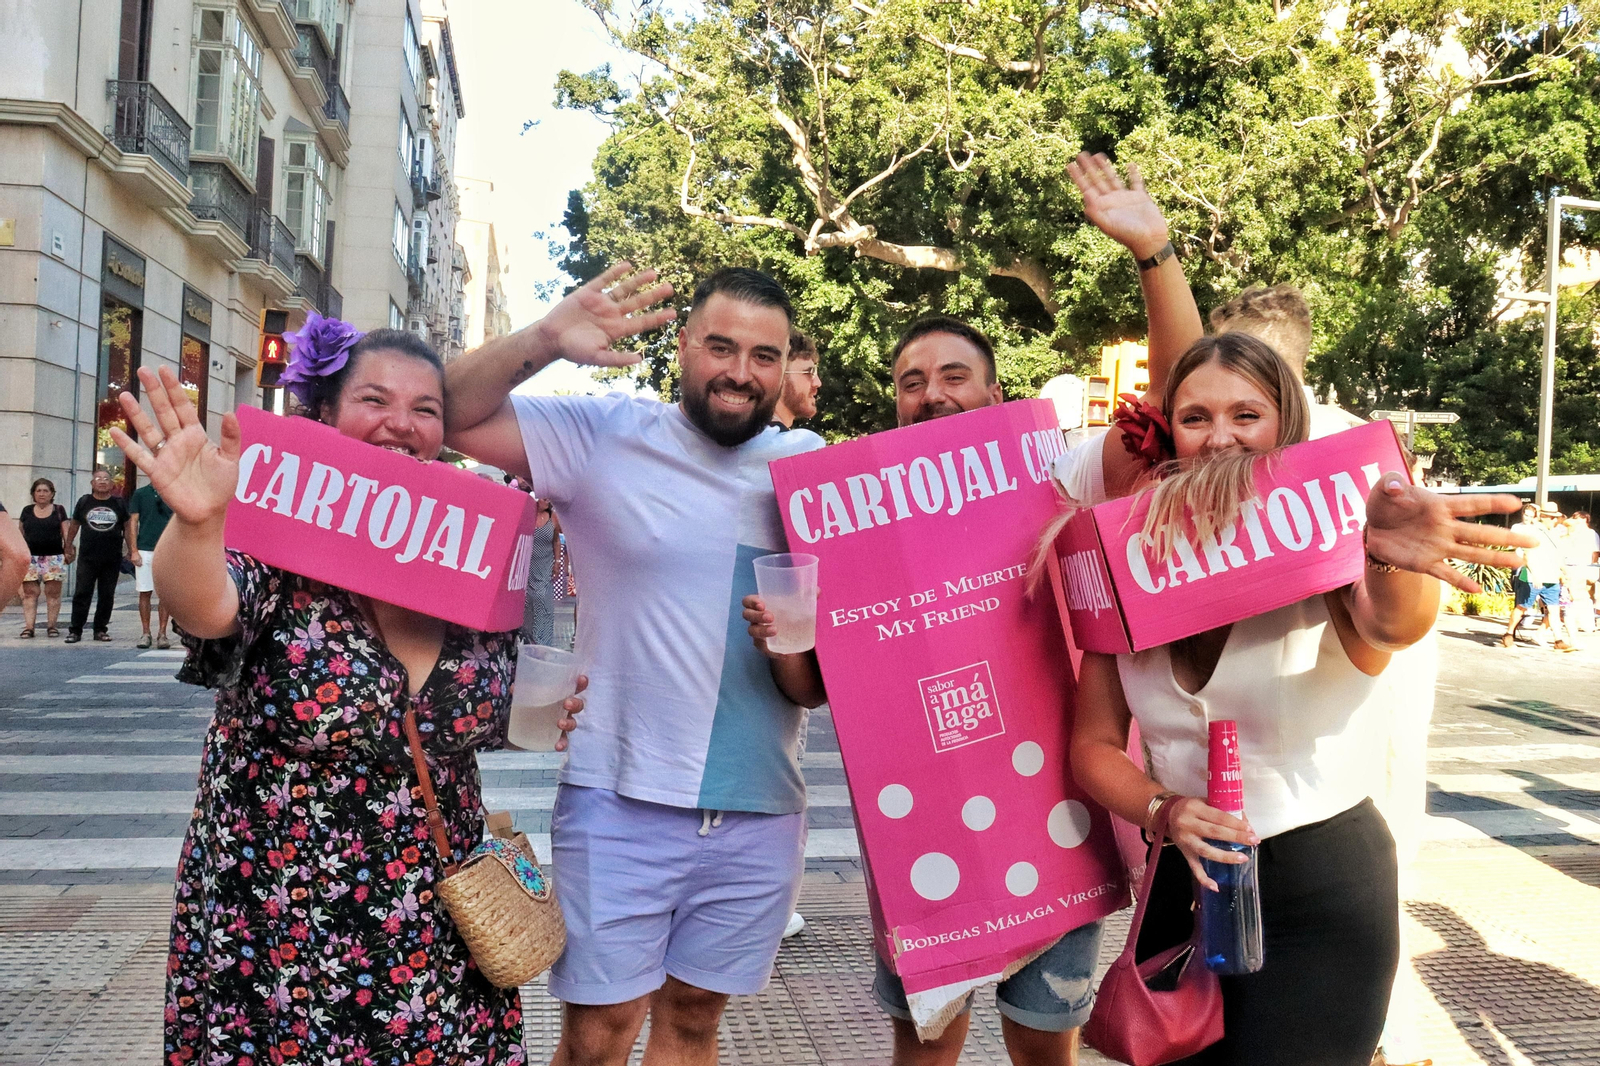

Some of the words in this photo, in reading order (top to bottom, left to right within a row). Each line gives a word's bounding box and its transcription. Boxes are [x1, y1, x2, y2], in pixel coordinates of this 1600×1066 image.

[235, 443, 495, 580] CARTOJAL
[789, 440, 1017, 544] CARTOJAL
[829, 598, 901, 627] ESTOY
[909, 589, 937, 607] DE
[943, 563, 1027, 598] MUERTE
[875, 619, 916, 641] MY
[920, 598, 1000, 630] FRIEND
[927, 680, 955, 693] sabor
[929, 694, 939, 704] a
[932, 701, 993, 731] laga
[902, 926, 981, 952] BODEGAS
[985, 904, 1055, 934] MÁLAGA
[1057, 881, 1117, 909] VIRGEN
